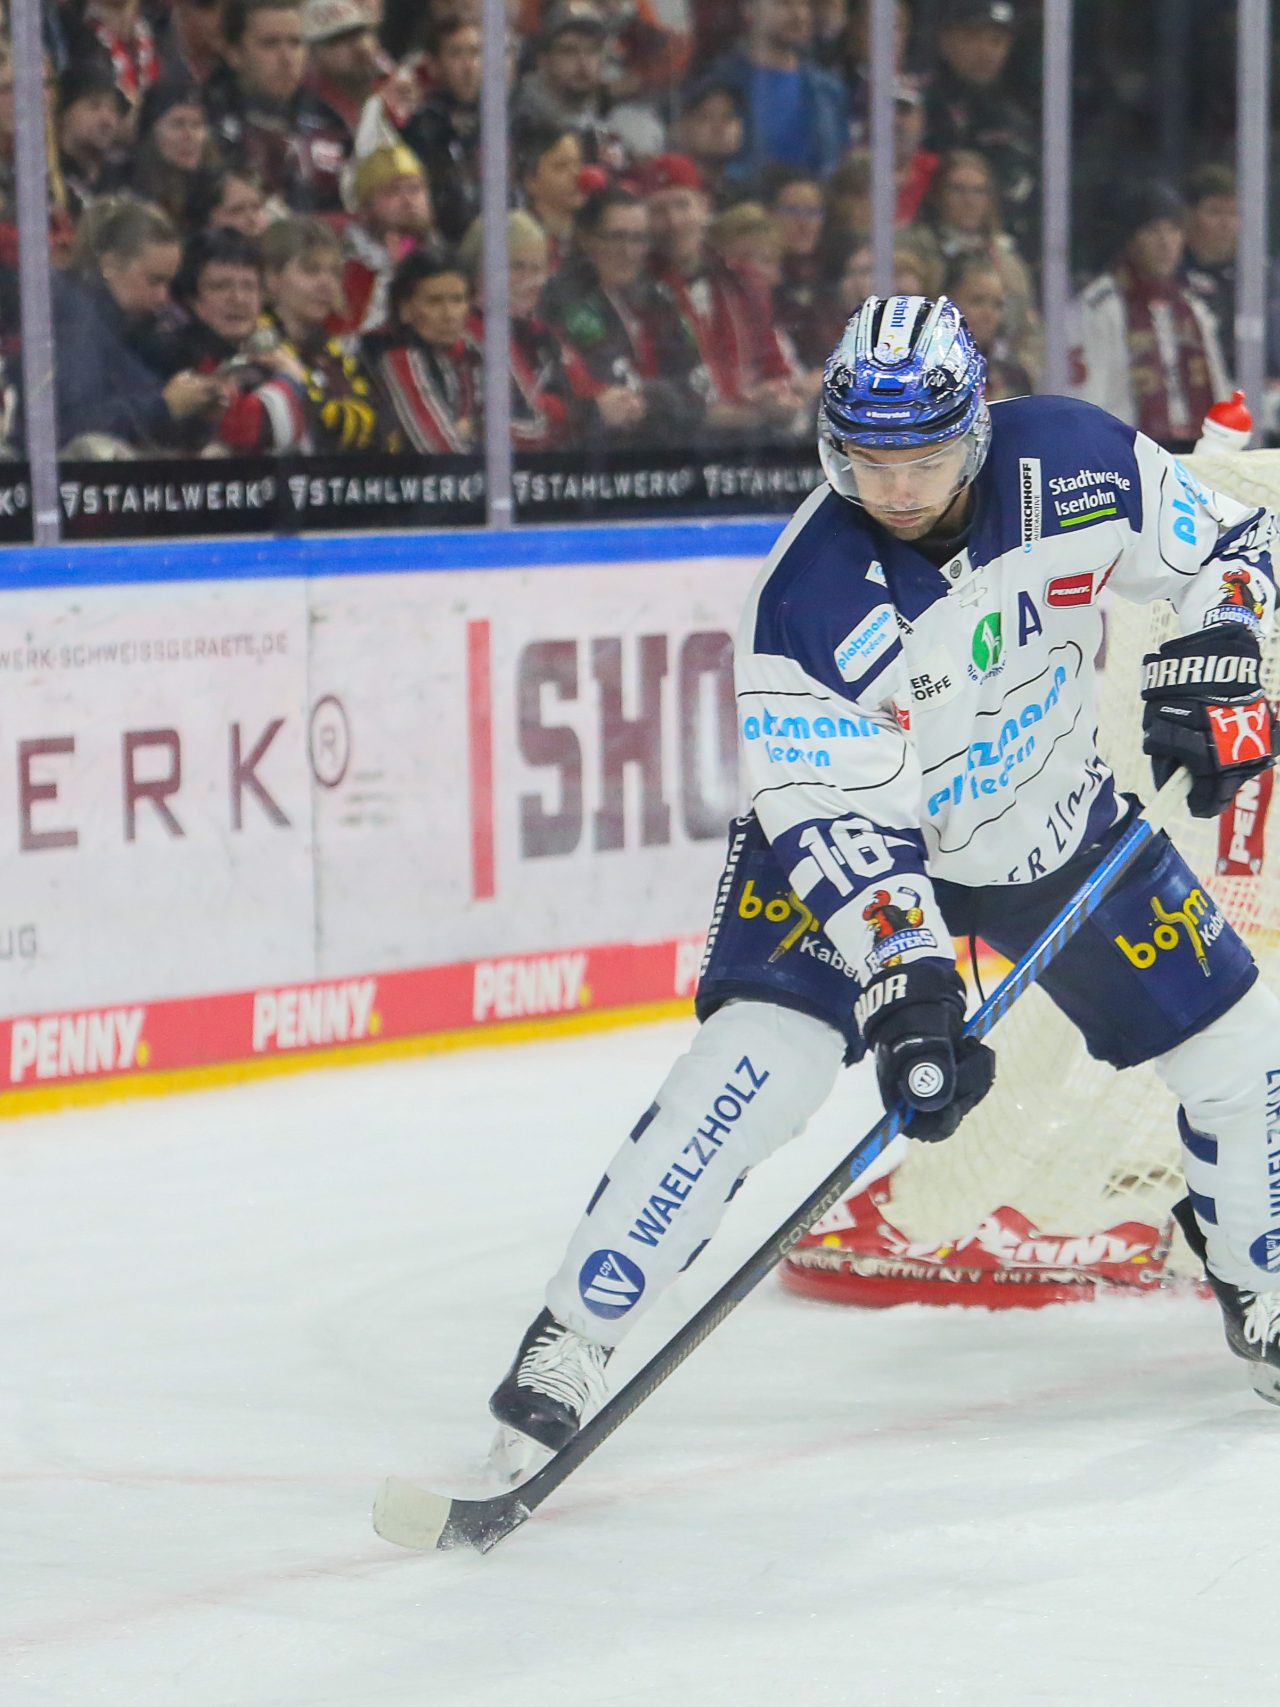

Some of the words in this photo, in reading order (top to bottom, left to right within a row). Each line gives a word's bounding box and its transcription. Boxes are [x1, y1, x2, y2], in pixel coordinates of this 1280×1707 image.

[1022, 462, 1033, 543] KIRCHHOFF
[1054, 489, 1116, 517] Iserlohn
[1018, 591, 1042, 648] A
[628, 1055, 771, 1248] WAELZHOLZ
[779, 1181, 843, 1255] COVERT
